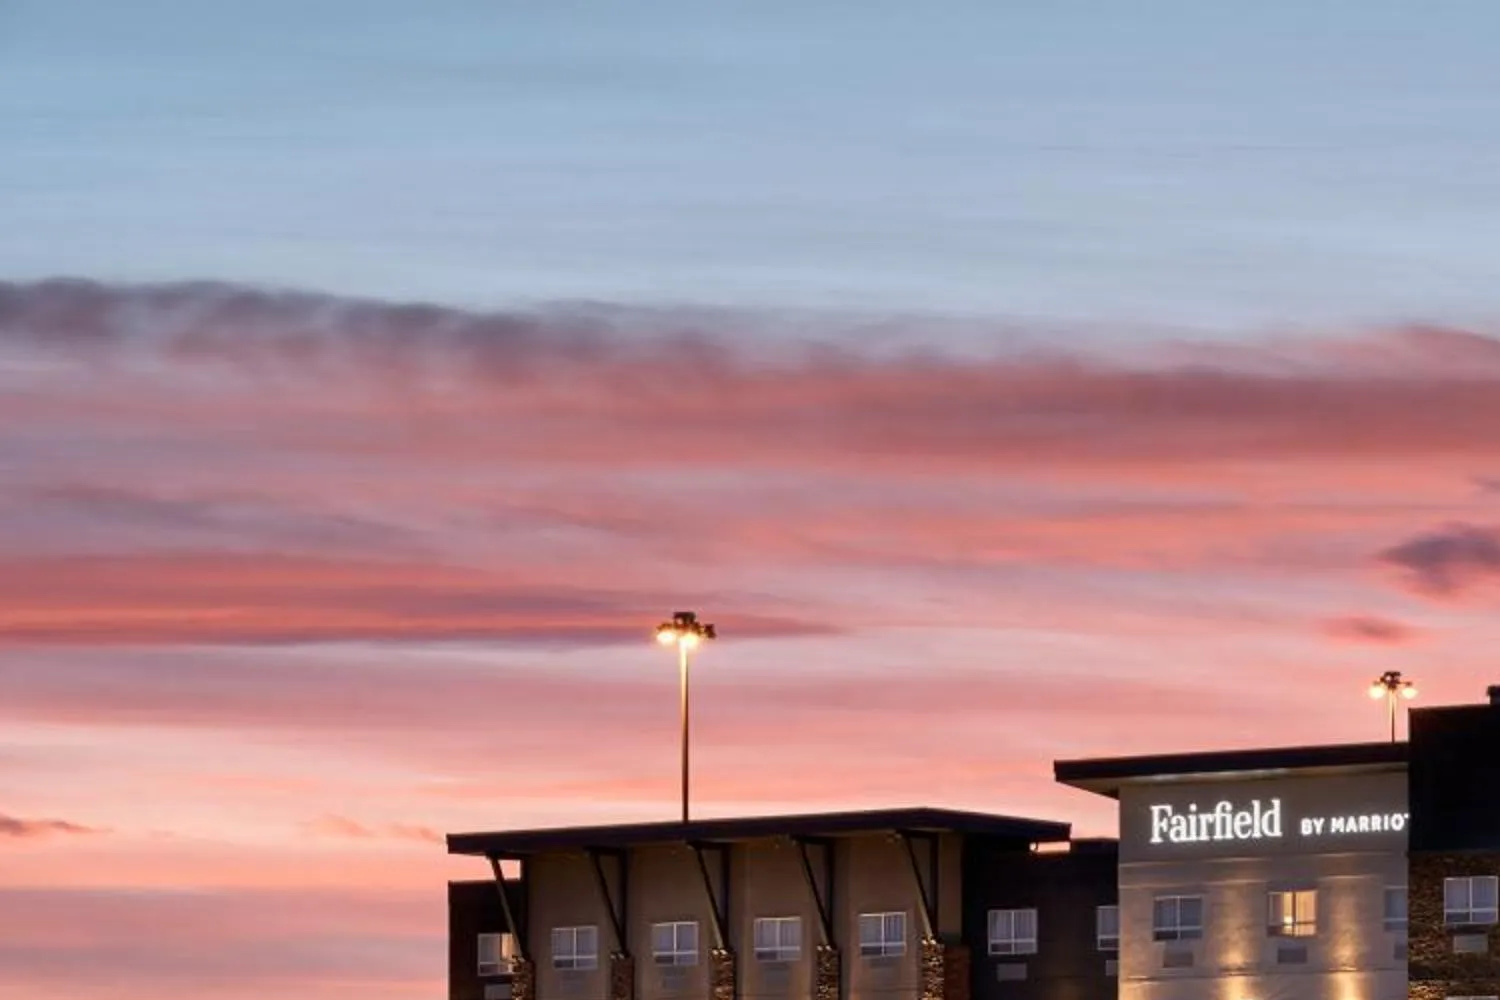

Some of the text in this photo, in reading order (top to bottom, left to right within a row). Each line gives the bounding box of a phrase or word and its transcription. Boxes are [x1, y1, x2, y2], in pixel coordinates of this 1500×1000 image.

[1149, 797, 1409, 844] Fairfield BY MARRIO
